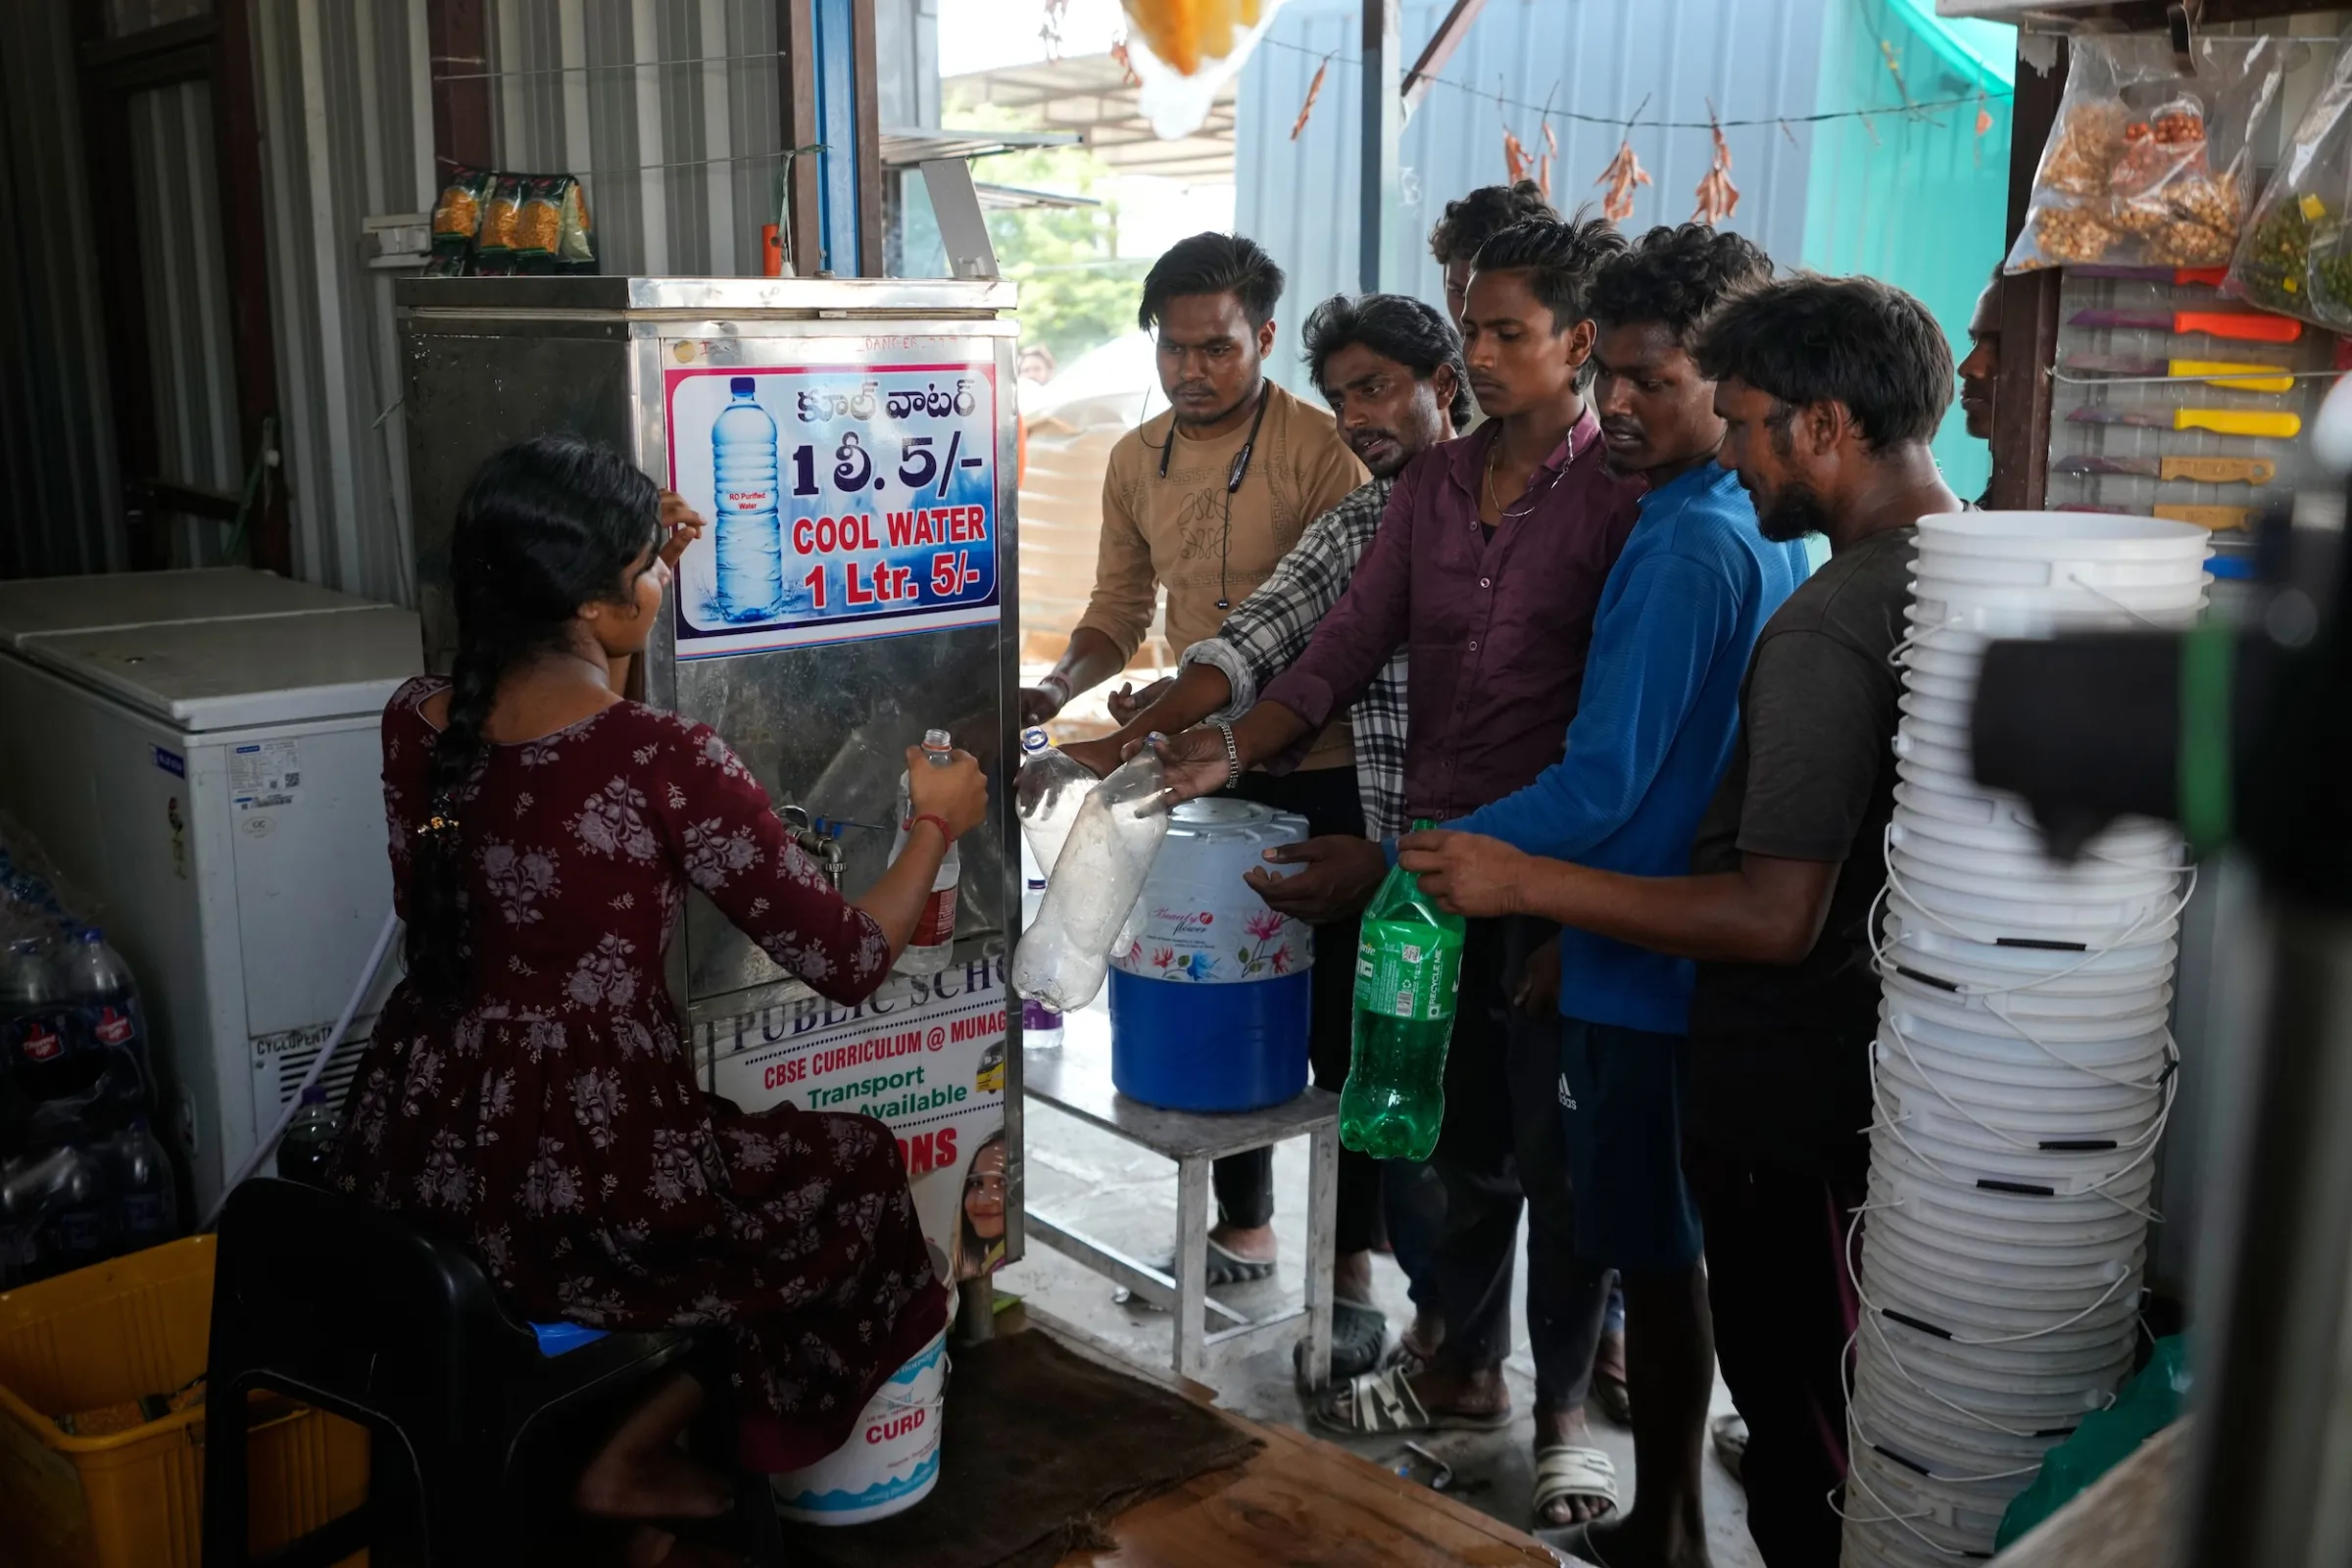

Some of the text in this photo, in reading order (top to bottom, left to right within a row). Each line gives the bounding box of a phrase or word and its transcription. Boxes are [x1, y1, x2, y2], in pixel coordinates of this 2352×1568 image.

[797, 379, 976, 422] కూల్ వాటర్
[793, 445, 819, 496] 1
[899, 430, 983, 497] 5/-
[741, 492, 765, 501] Purified
[792, 504, 985, 555] COOL WATER
[805, 552, 980, 609] 1 Ltr. 5/-
[1429, 966, 1441, 1004] RECYCLE
[1435, 949, 1443, 962] ME
[764, 1057, 807, 1090] CBSE
[812, 1030, 922, 1076] CURRICULUM
[927, 1026, 946, 1053] @
[951, 1009, 1006, 1043] MUNAG
[808, 1066, 925, 1109] Transport
[859, 1084, 967, 1120] Available
[866, 1407, 926, 1446] CURD
